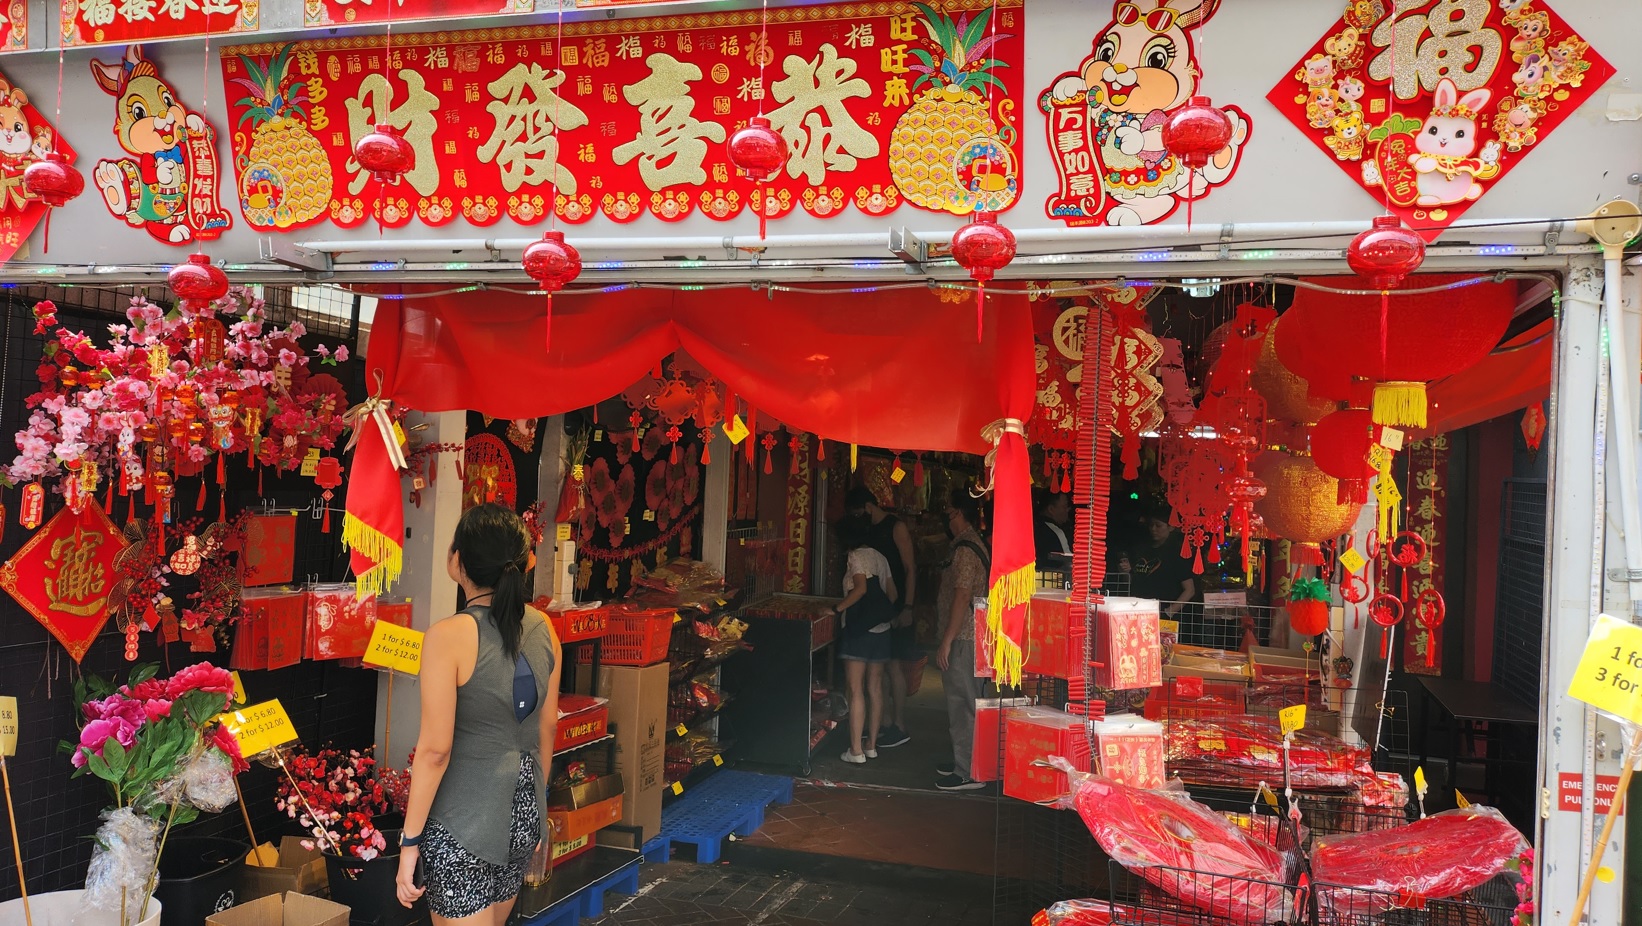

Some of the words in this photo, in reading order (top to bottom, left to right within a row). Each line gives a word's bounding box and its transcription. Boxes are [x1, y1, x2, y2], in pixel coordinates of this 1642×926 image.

[297, 50, 329, 130] 钱多多
[1058, 107, 1094, 196] 万事如意
[192, 140, 212, 214] 恭喜发财
[388, 634, 398, 643] for
[406, 640, 420, 650] 6.80
[382, 646, 392, 654] for
[394, 648, 399, 656] $
[400, 650, 418, 661] 12.00
[1610, 646, 1622, 661] 1
[1595, 667, 1608, 682] 3
[1612, 672, 1638, 694] for
[254, 712, 260, 720] $
[260, 708, 276, 718] 6.80
[239, 732, 245, 740] 2
[246, 728, 258, 736] for
[258, 724, 264, 732] $
[265, 718, 284, 730] 12.00
[1562, 780, 1618, 792] EMEENC
